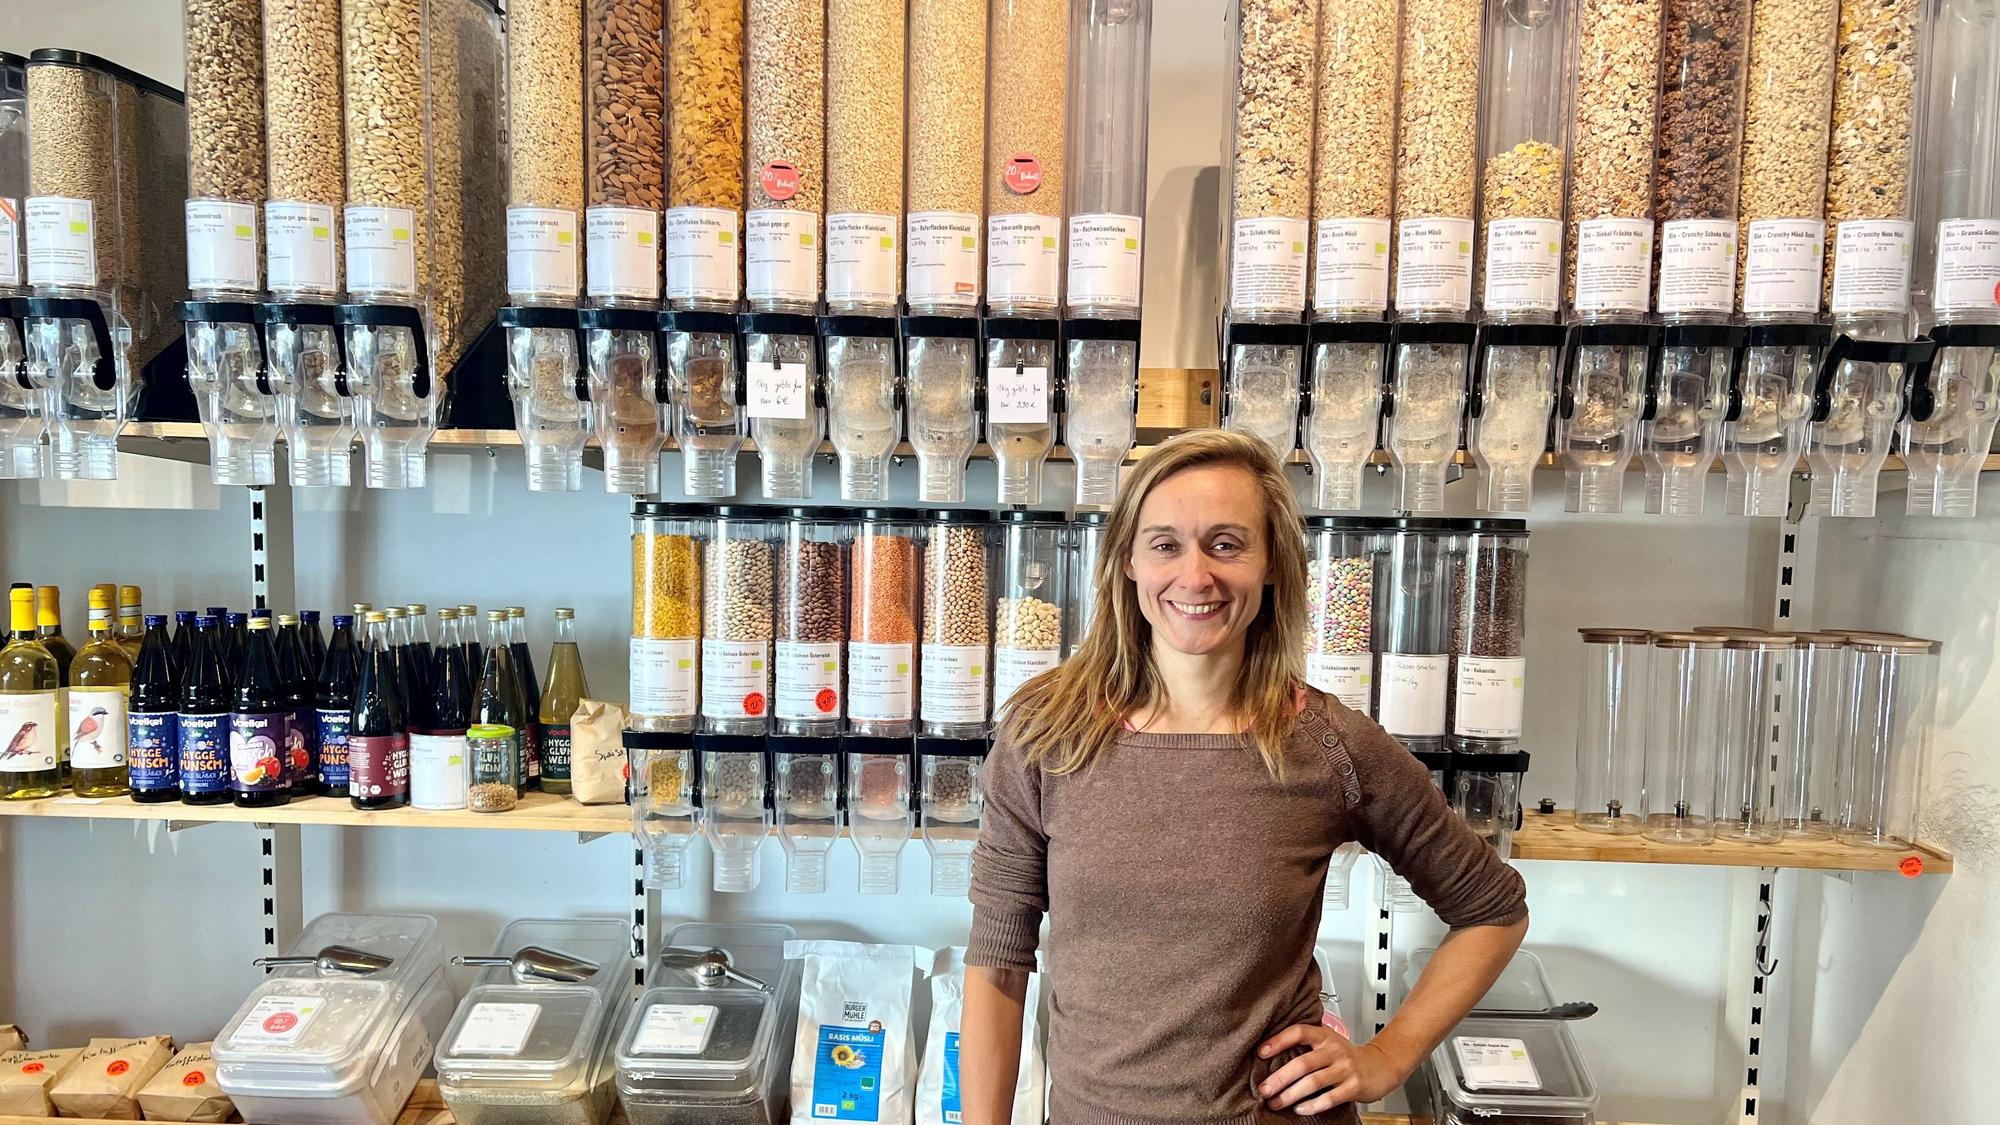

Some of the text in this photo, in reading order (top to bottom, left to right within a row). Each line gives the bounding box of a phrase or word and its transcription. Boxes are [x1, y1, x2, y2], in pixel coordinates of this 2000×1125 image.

[1682, 231, 1704, 240] Crunchy
[1767, 231, 1790, 240] Crunchy
[1857, 231, 1880, 240] Crunchy
[129, 717, 163, 727] Voelkel
[181, 719, 217, 729] Voelkel
[232, 718, 268, 729] Voelkel
[131, 748, 162, 758] HYGGE
[183, 750, 216, 760] HYGGE
[323, 745, 348, 755] HYGG
[128, 757, 169, 769] PUNSCH
[180, 759, 223, 771] PUNSCH
[844, 1003, 866, 1012] BURGER
[828, 1033, 874, 1043] BASIS MÜSLI
[849, 1092, 859, 1100] kg
